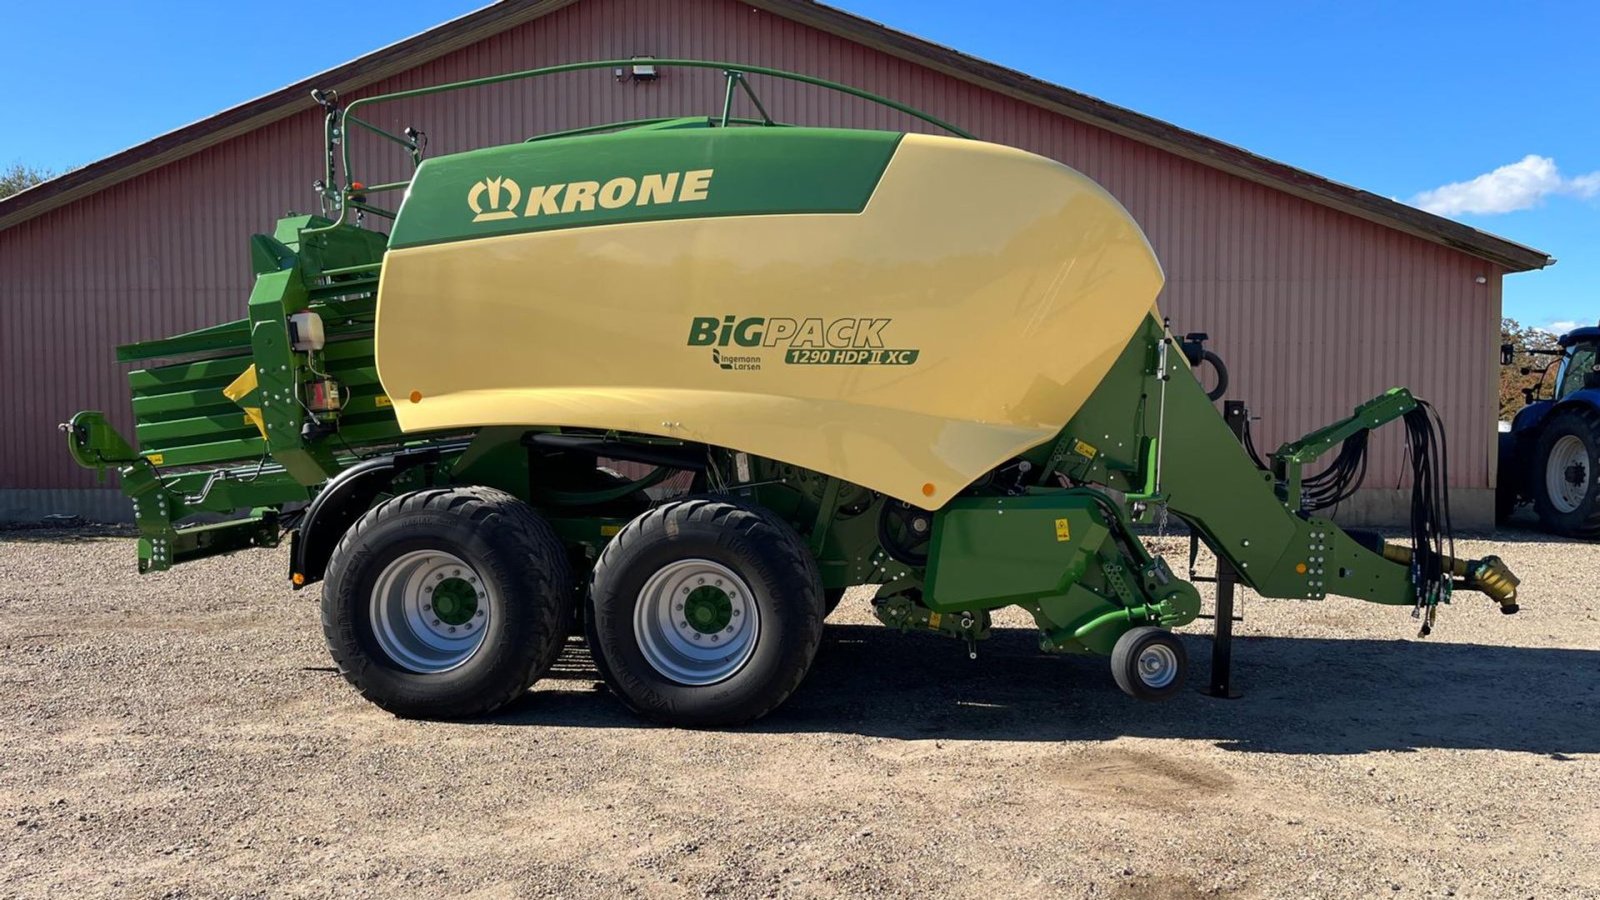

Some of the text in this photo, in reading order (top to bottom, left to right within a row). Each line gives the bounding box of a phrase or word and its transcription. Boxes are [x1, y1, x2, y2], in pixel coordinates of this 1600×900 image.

[524, 169, 714, 217] KRONE
[721, 355, 761, 364] Ingemann
[791, 350, 830, 363] 1290
[885, 351, 911, 364] XC
[734, 363, 761, 371] Larsen
